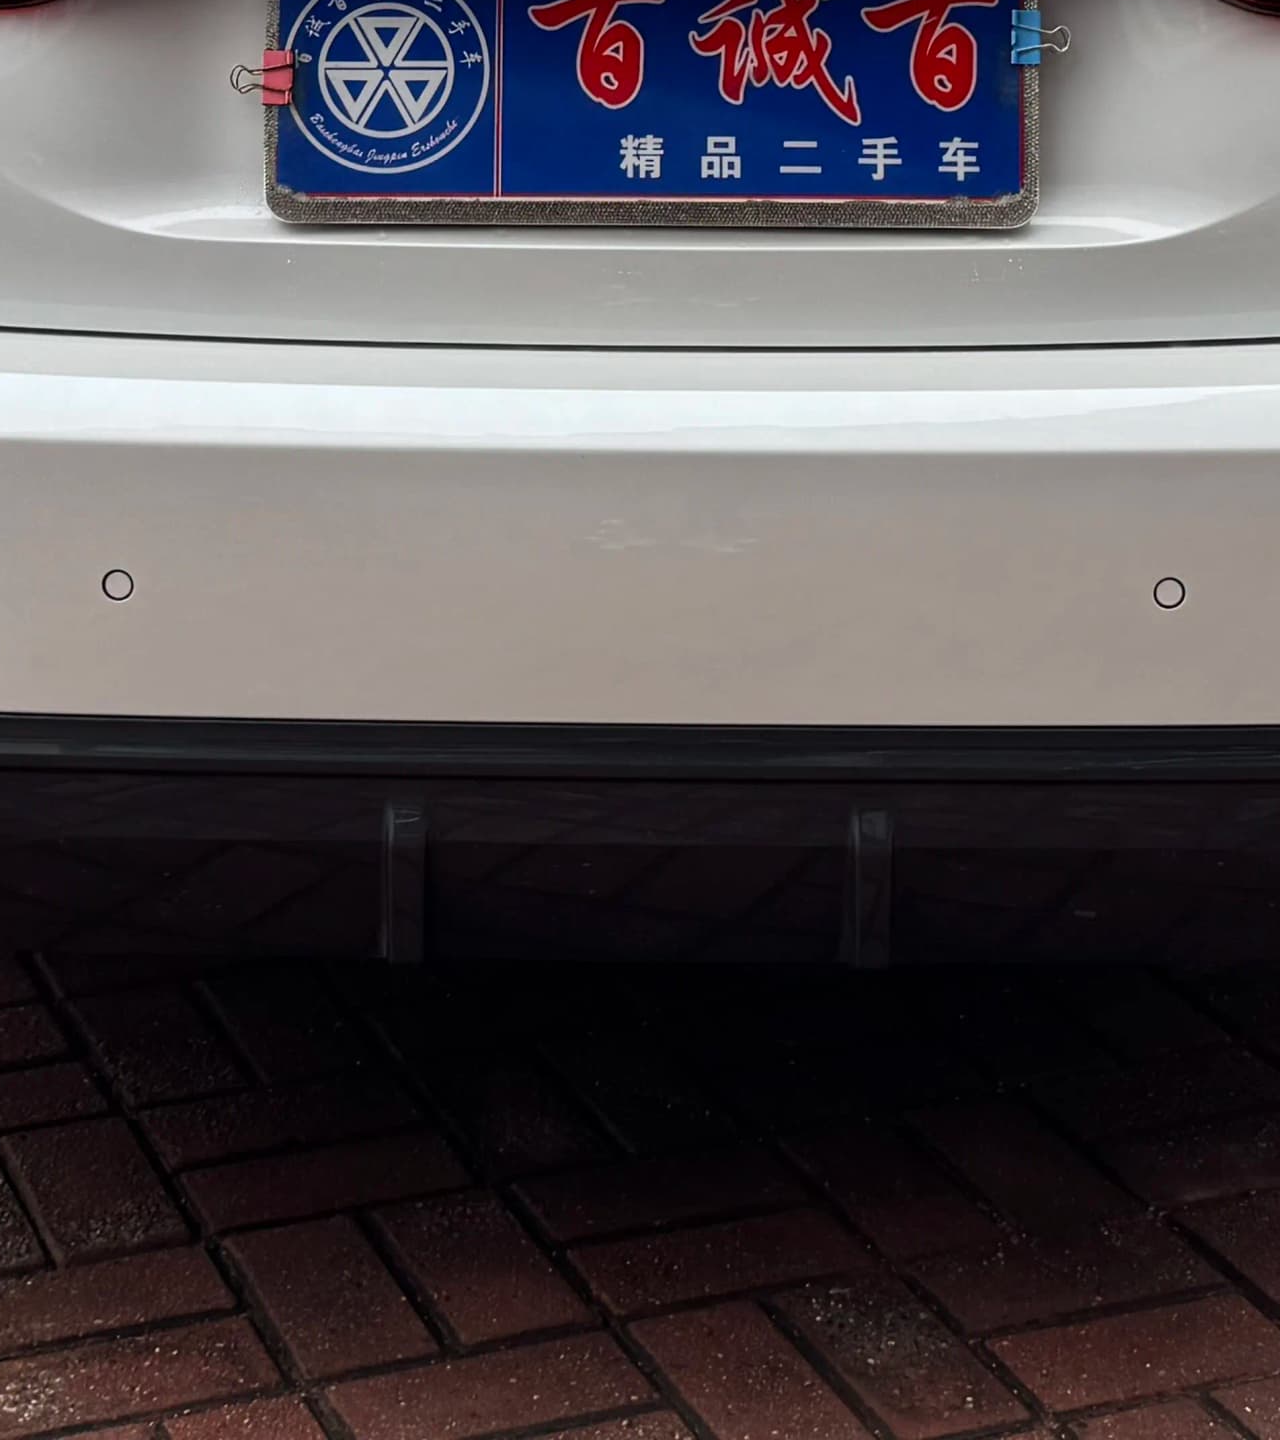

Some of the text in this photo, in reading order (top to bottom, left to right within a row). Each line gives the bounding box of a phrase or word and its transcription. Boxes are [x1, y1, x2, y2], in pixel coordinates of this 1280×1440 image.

[619, 134, 980, 181] 精品二手车
